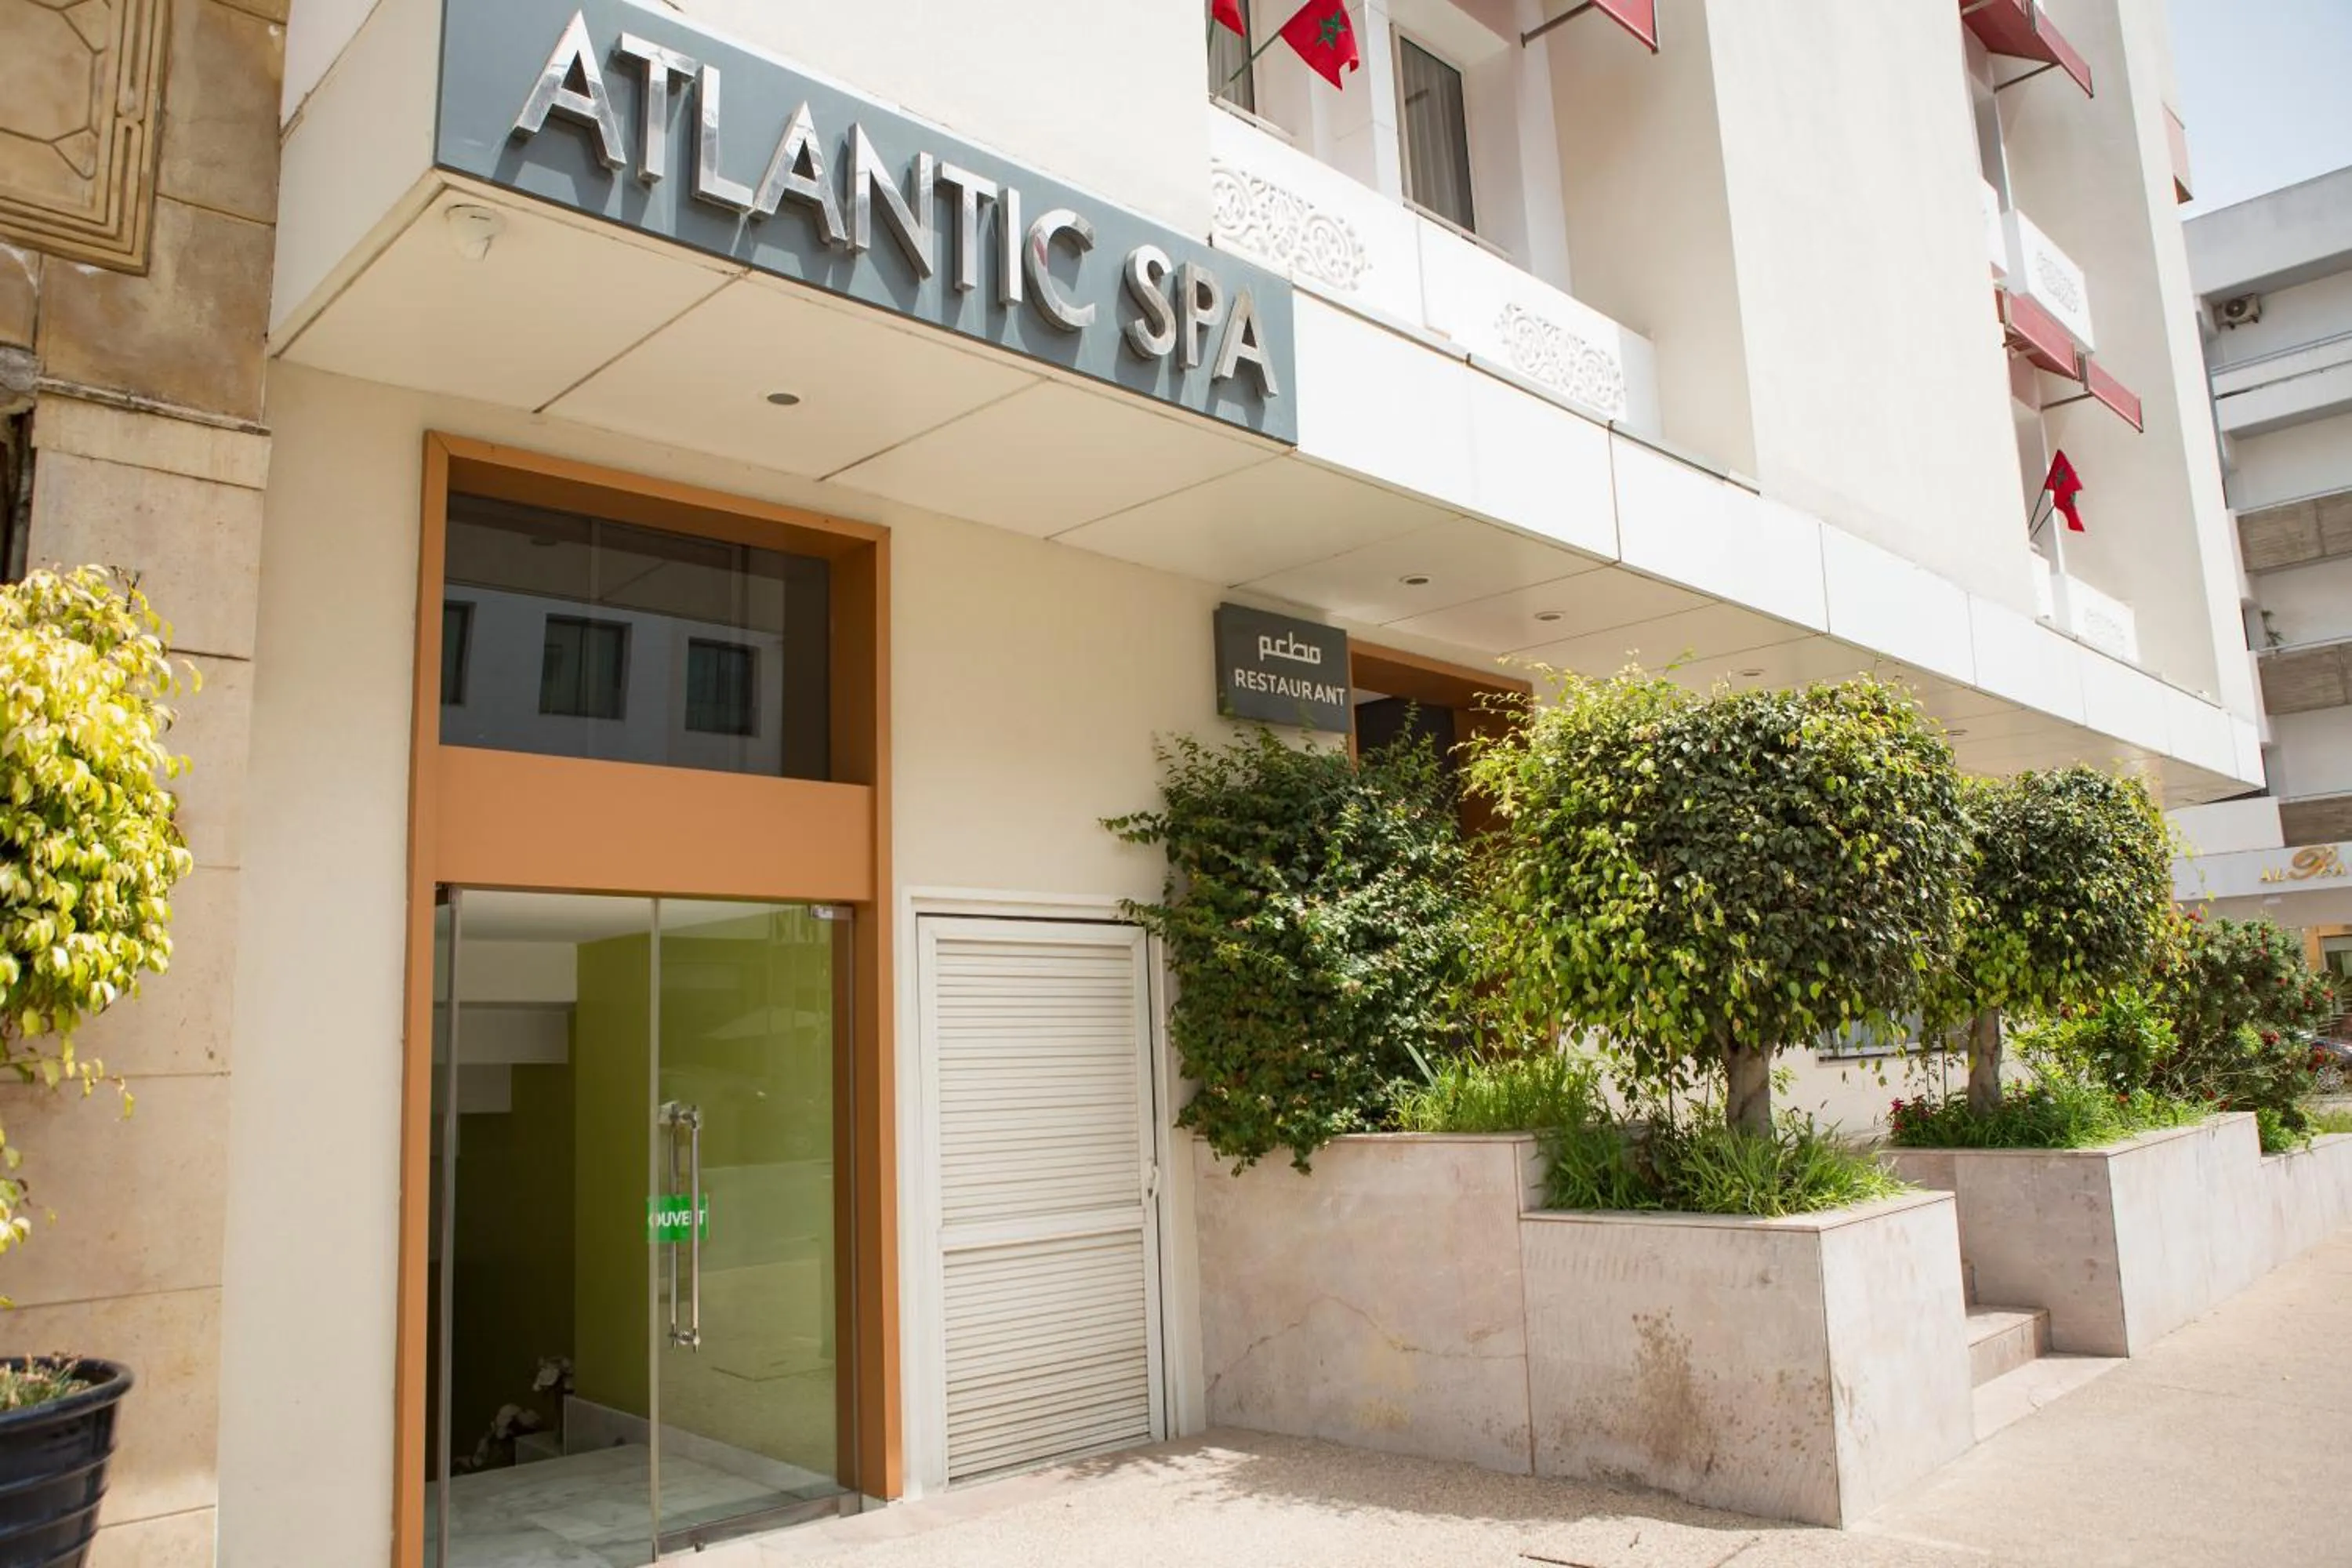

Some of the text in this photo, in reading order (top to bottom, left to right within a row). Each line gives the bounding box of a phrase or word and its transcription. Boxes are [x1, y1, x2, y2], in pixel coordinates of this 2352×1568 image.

[511, 9, 1278, 398] ATLANTIC SPA
[1258, 630, 1322, 665] مطعم
[1234, 668, 1346, 706] RESTAURANT
[648, 1209, 706, 1228] OUVET
